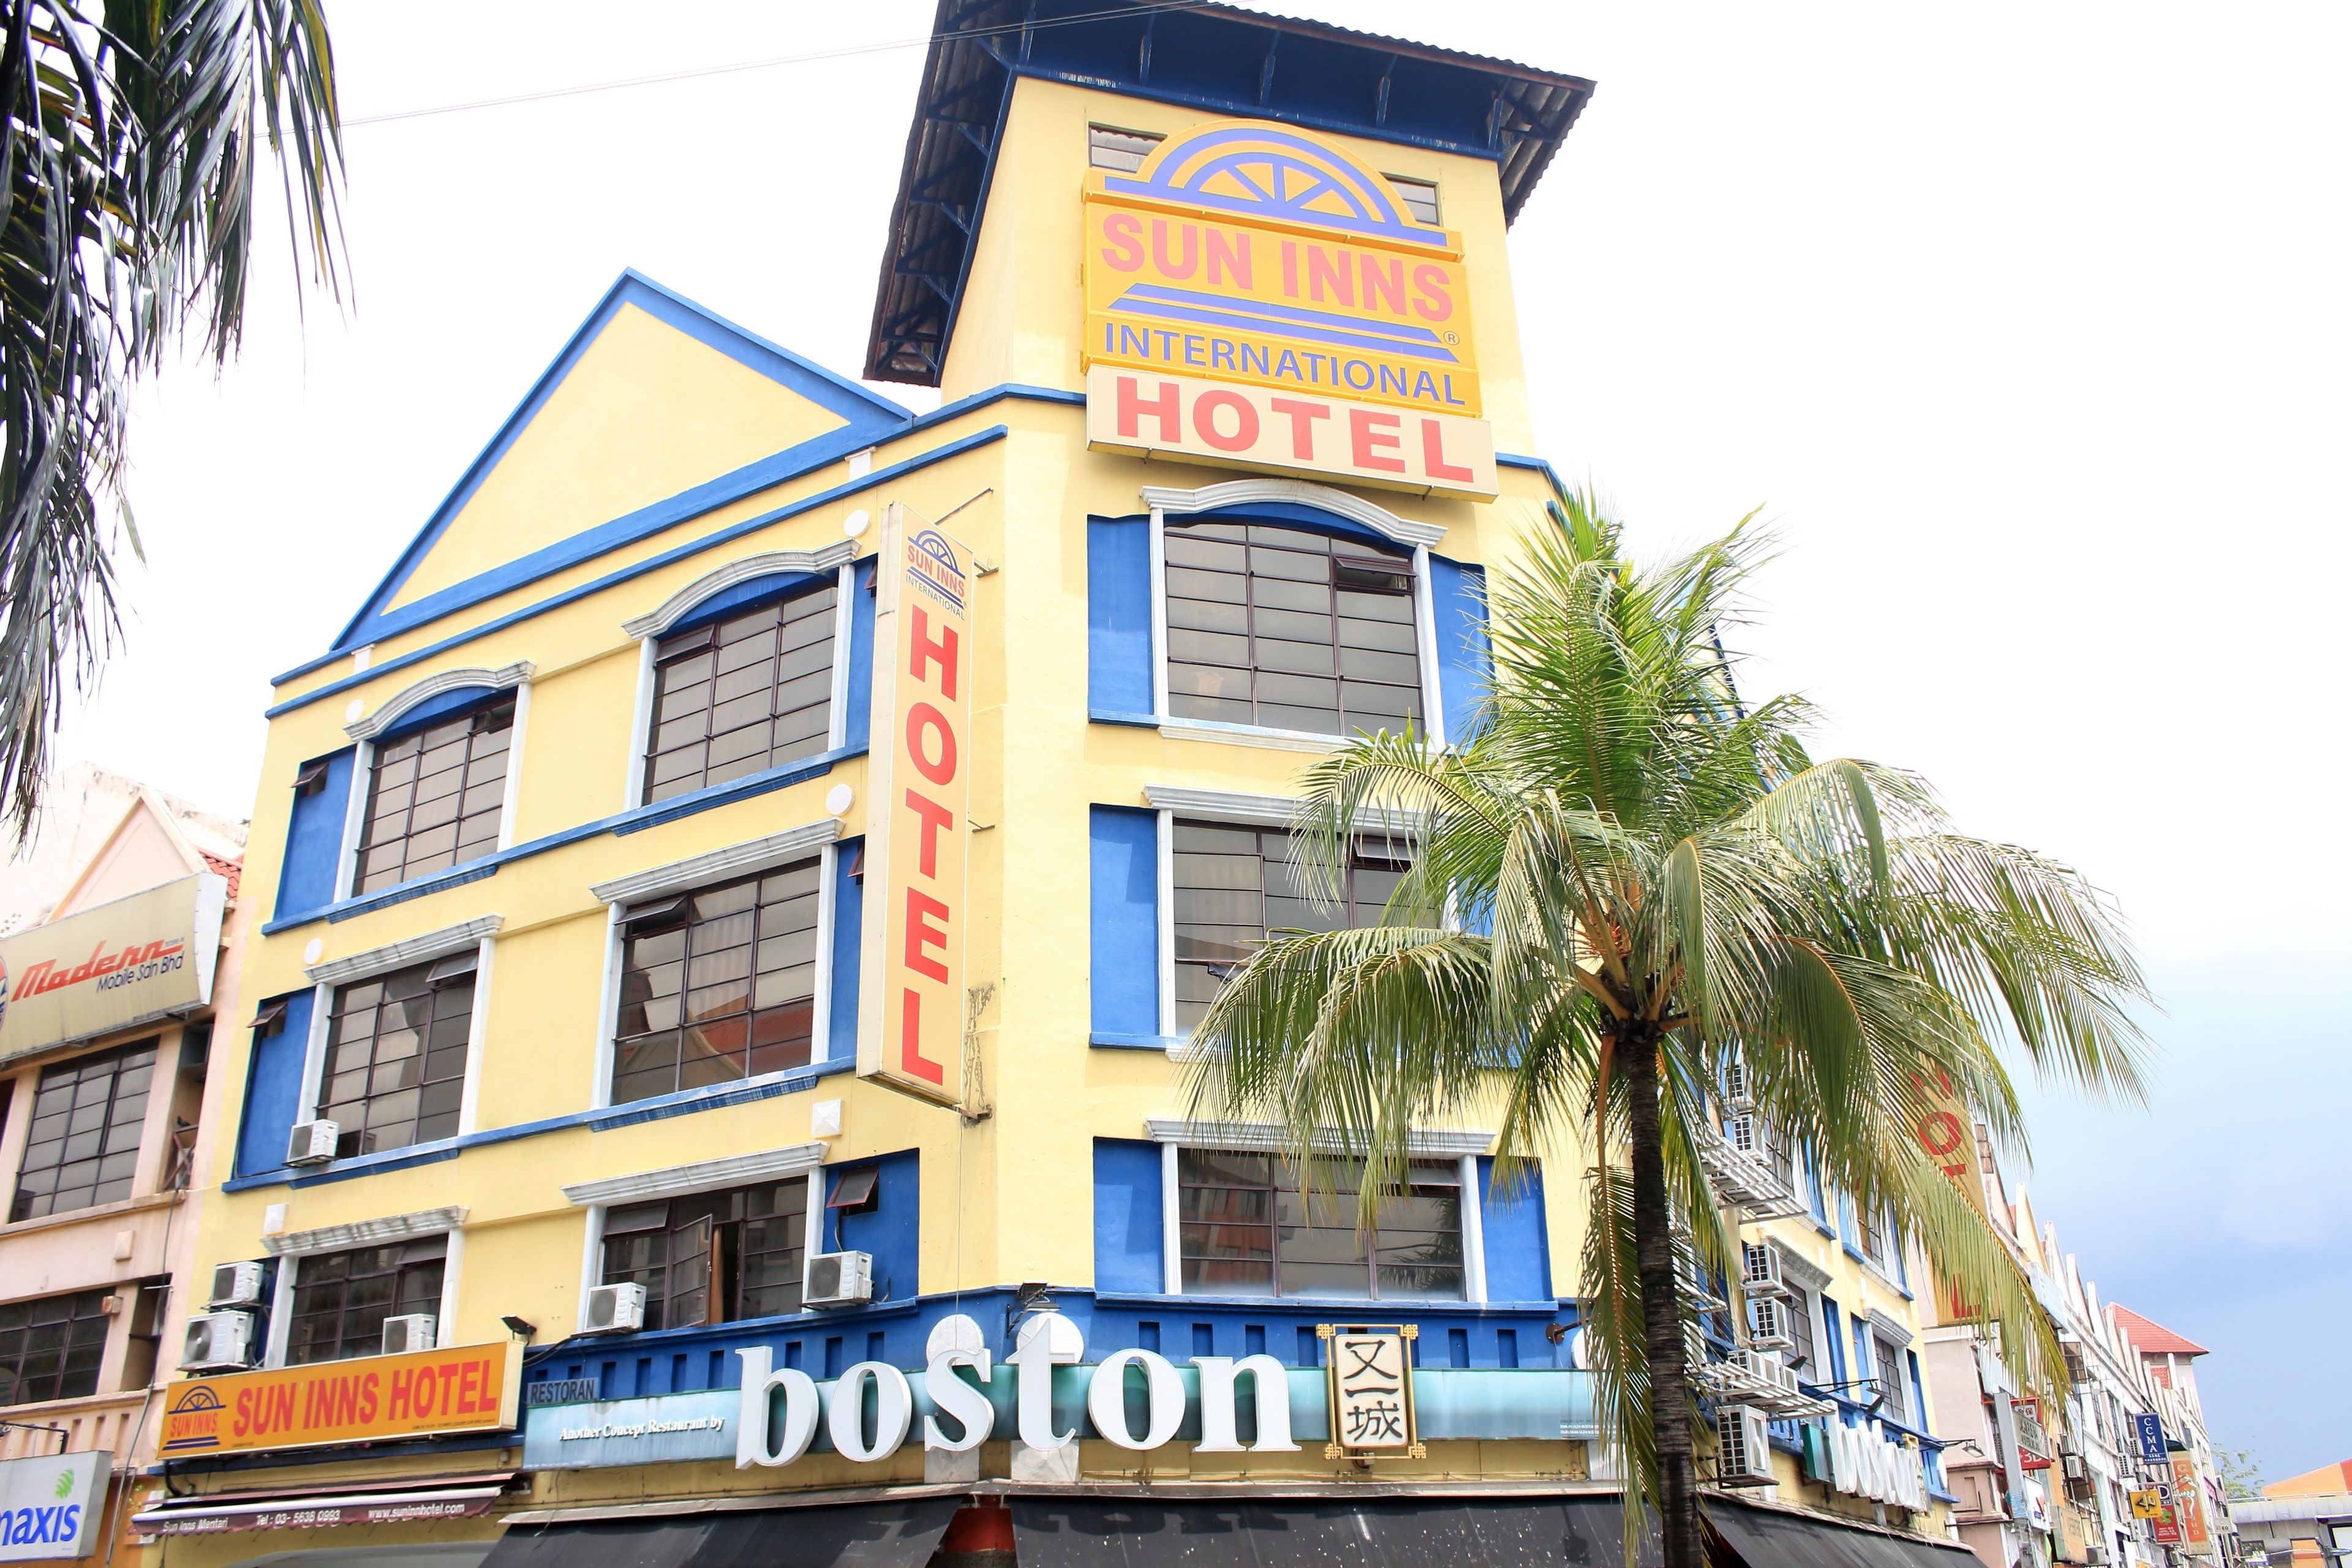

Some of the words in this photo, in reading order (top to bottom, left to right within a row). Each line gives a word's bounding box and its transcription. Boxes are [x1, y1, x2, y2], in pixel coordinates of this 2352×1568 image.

[1102, 213, 1253, 290] SUN
[1283, 239, 1453, 322] INNS
[1105, 322, 1466, 405] INTERNATIONAL
[1116, 375, 1474, 483] HOTEL
[905, 574, 965, 620] INTERNATIONAL
[907, 545, 933, 576] SUN
[937, 564, 965, 598] INNS
[901, 603, 959, 1087] HOTEL
[96, 968, 134, 993] Mobile
[160, 951, 185, 974] Bhd
[233, 1382, 297, 1438] SUN
[303, 1372, 380, 1430] INNS
[388, 1359, 497, 1421] HOTEL
[530, 1379, 595, 1403] RESTORAN
[736, 1311, 1302, 1470] boston
[1343, 1338, 1403, 1442] 又一城
[170, 1415, 192, 1438] SUN
[193, 1412, 219, 1434] INNS
[559, 1427, 602, 1441] Another
[603, 1423, 644, 1438] Concept
[647, 1417, 707, 1434] Restaurant
[710, 1414, 726, 1432] by
[2144, 1417, 2158, 1453] CCMA
[163, 1521, 178, 1532] Sun
[179, 1520, 195, 1531] Inns
[198, 1517, 228, 1529] Mentari
[293, 1511, 315, 1523] 5638
[317, 1509, 341, 1521] 0993
[368, 1503, 465, 1518] www.suninnhotel.com
